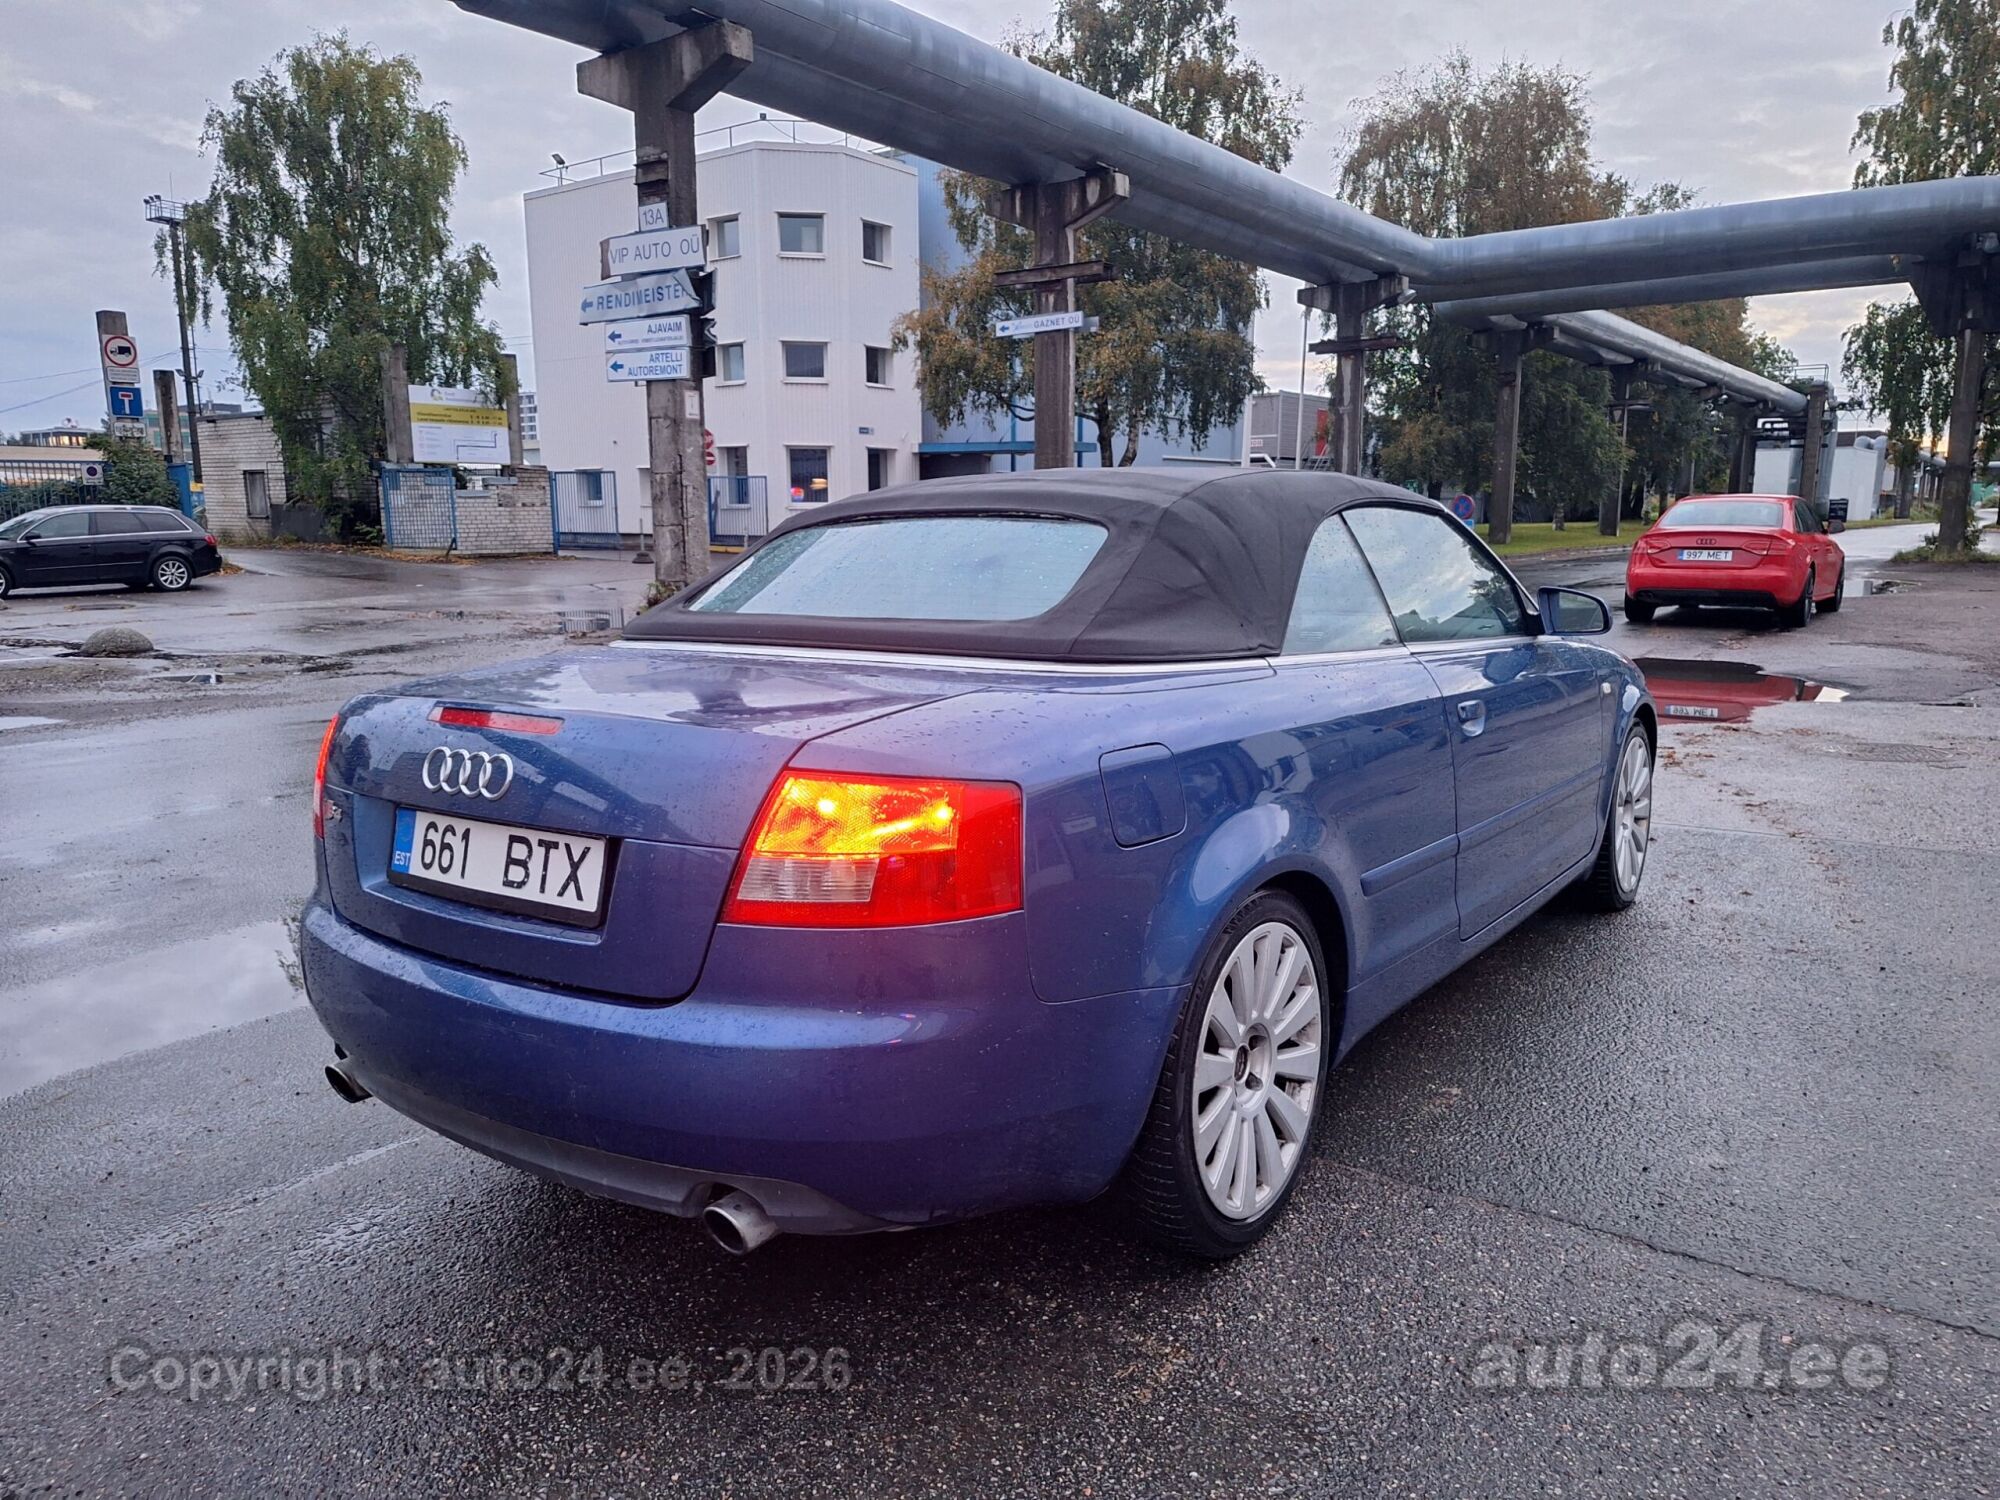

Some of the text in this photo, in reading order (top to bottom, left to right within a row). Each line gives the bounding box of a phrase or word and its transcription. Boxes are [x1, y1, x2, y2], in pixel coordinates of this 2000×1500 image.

[642, 208, 664, 226] 13A
[609, 234, 699, 264] VIP AUTO OÜ
[647, 322, 682, 334] AJAVAIM
[1033, 317, 1066, 329] GAZNET
[649, 353, 683, 363] ARTELLI
[628, 364, 683, 376] AUTOREMONT
[1686, 551, 1703, 559] 997
[1707, 551, 1729, 559] MET
[394, 851, 411, 866] EST
[420, 821, 591, 901] 661 BTX
